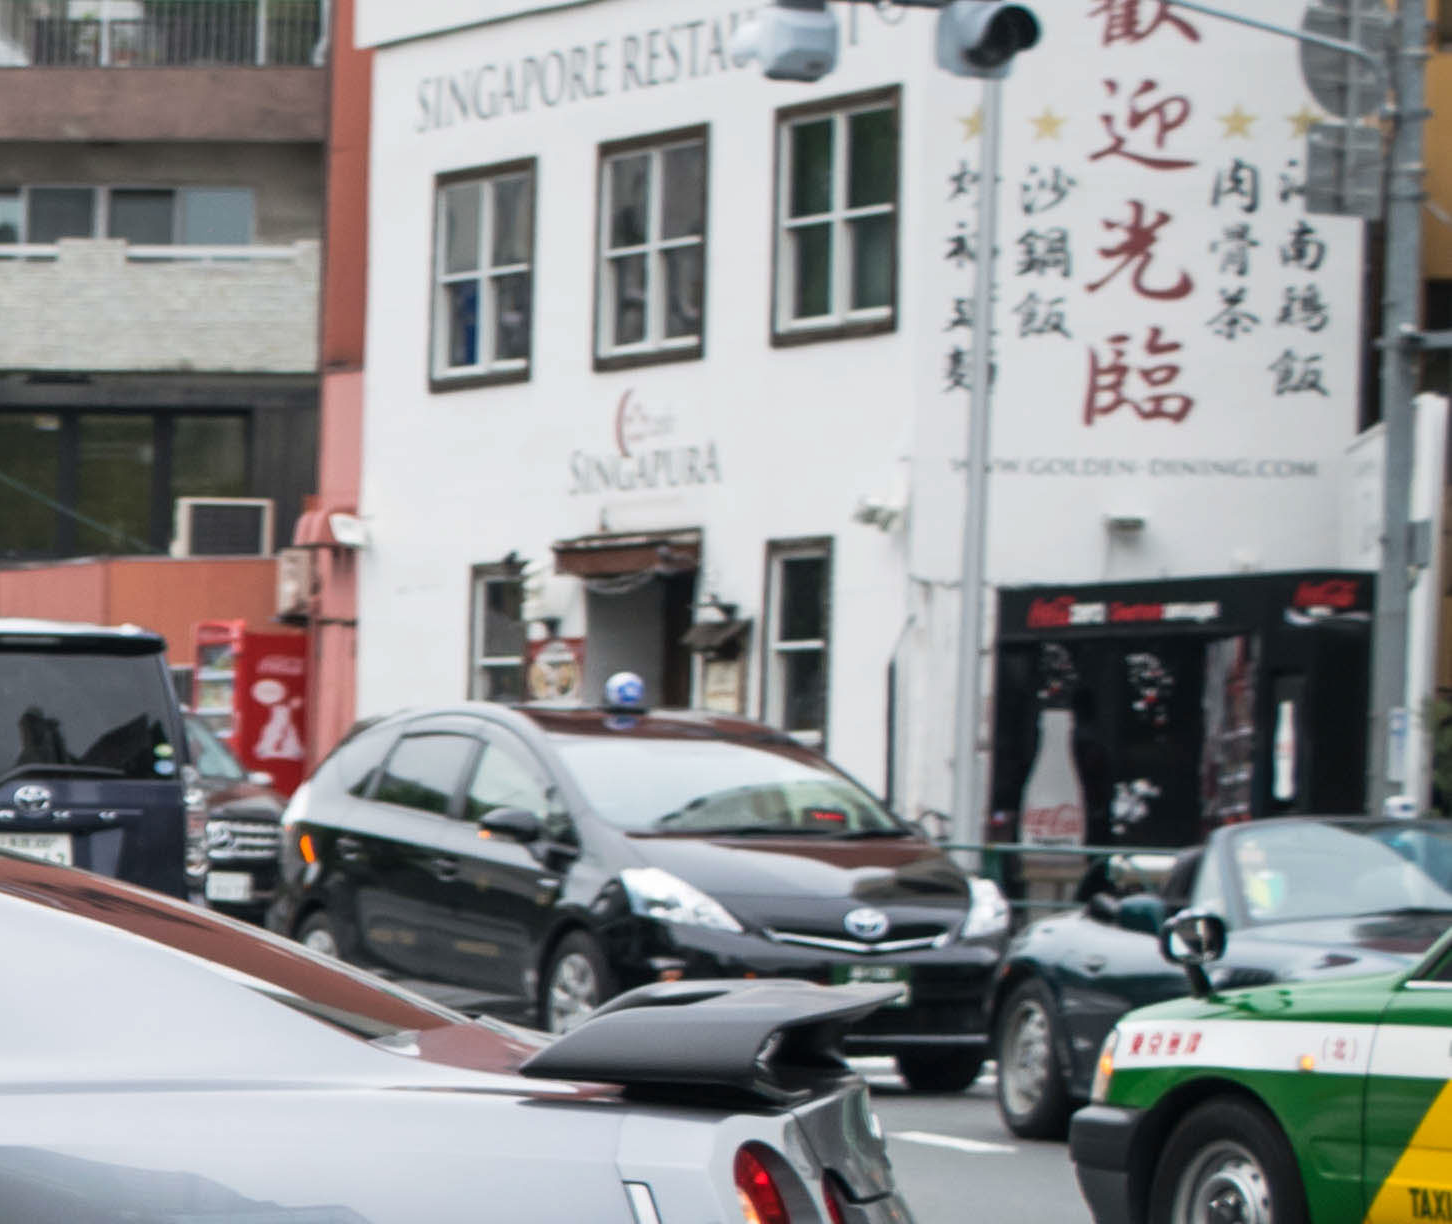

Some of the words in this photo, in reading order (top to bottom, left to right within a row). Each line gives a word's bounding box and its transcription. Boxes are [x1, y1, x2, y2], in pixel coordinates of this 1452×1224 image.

[414, 40, 608, 133] SINGAPORE
[1205, 157, 1261, 341] 肉骨茶
